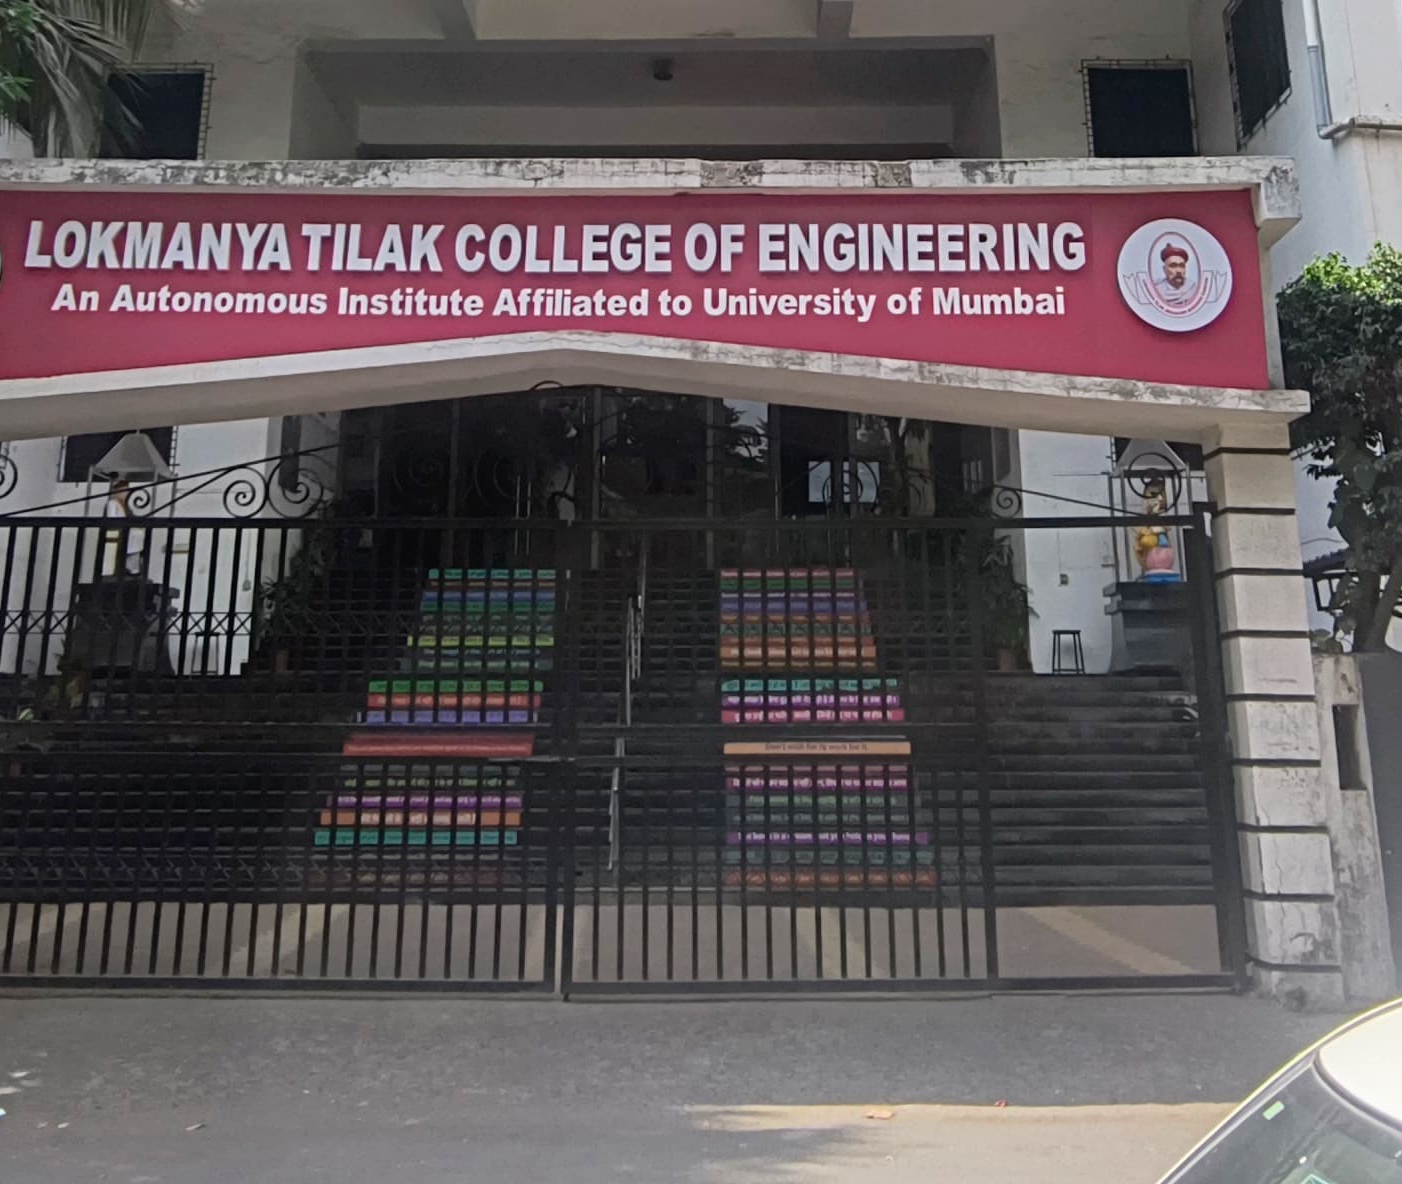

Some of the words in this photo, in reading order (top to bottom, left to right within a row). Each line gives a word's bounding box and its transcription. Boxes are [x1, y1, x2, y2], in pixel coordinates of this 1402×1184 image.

[24, 220, 292, 271] LOKMANYA
[301, 223, 445, 272] TILAK
[455, 223, 672, 273] COLLEGE
[684, 222, 745, 272] OF
[758, 222, 1086, 272] ENGINEERING
[51, 283, 100, 312] An
[109, 284, 328, 315] Autonomous
[337, 287, 484, 317] Institute
[492, 287, 649, 317] Affiliated
[657, 289, 693, 317] to
[703, 287, 877, 323] University
[886, 286, 923, 315] of
[932, 285, 1065, 316] Mumbai
